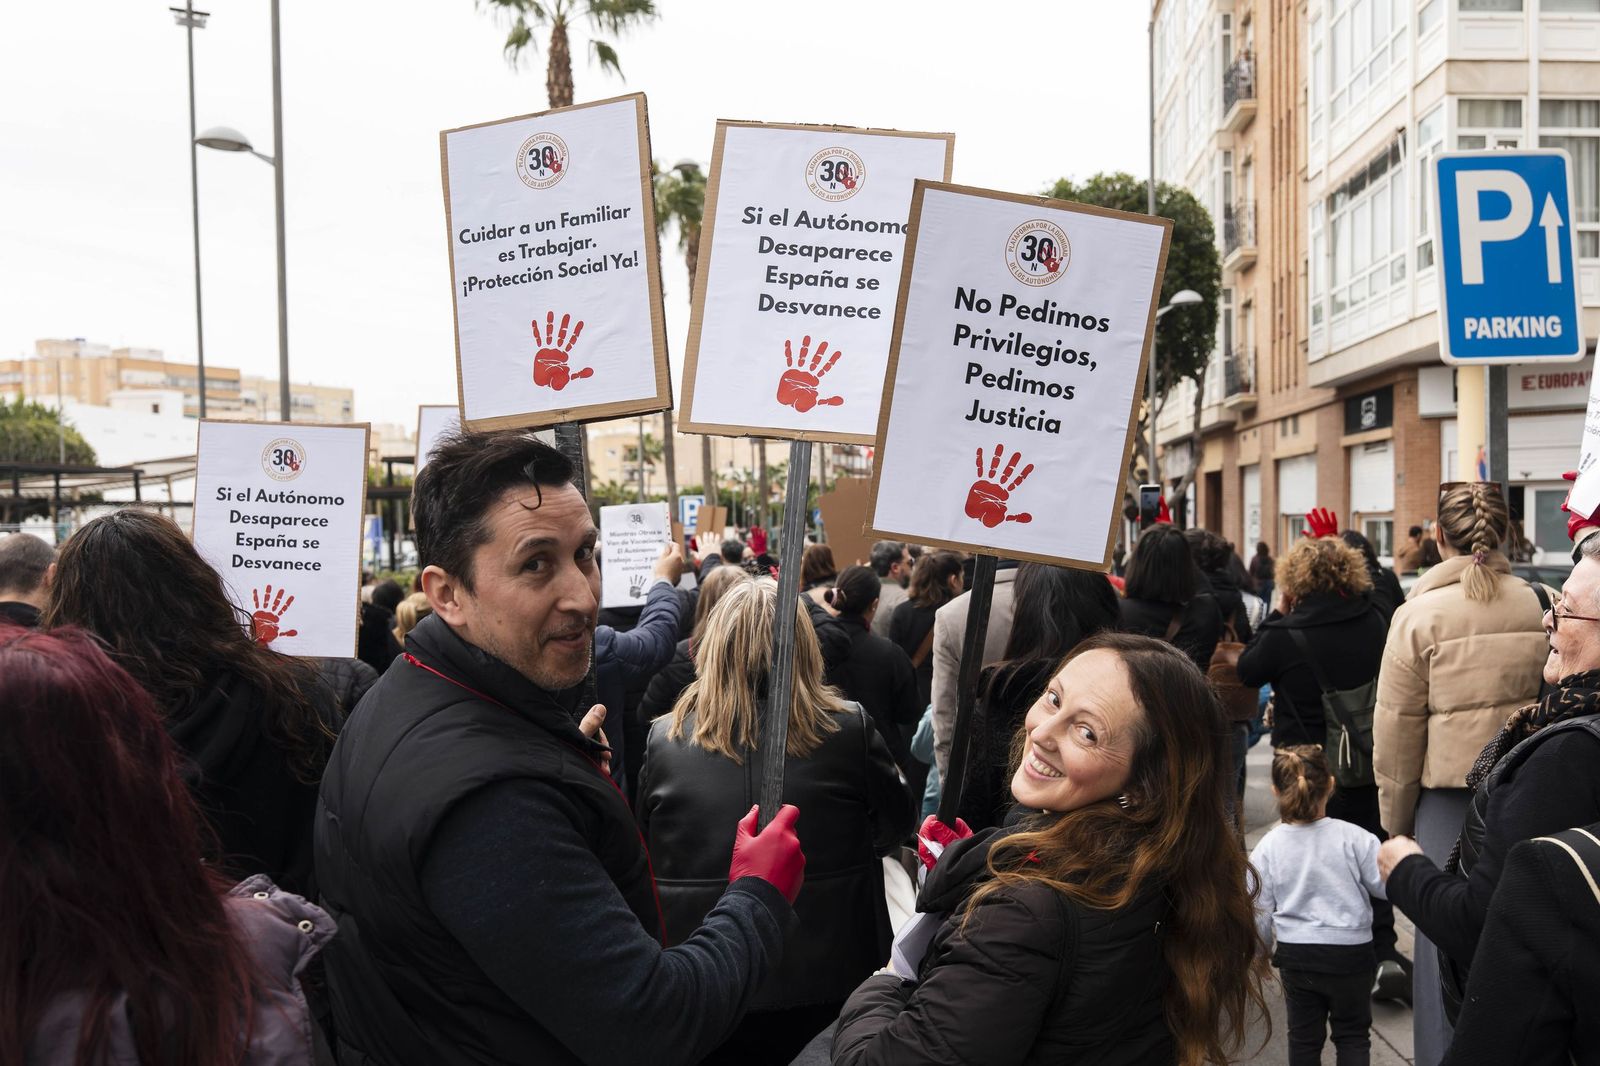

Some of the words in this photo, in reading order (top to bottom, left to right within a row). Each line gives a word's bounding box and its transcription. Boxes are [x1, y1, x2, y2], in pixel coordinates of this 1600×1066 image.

[529, 146, 554, 170] 30
[820, 160, 849, 182] 30
[460, 224, 515, 244] Cuidar
[520, 224, 530, 234] a
[535, 220, 556, 232] un
[561, 206, 631, 228] Familiar
[742, 207, 763, 224] Si
[769, 208, 788, 226] el
[1455, 170, 1534, 285] P
[499, 251, 515, 262] es
[519, 236, 596, 256] Trabajar.
[759, 236, 892, 262] Desaparece
[1008, 223, 1035, 252] PLATAFORMA
[1048, 225, 1056, 233] LA
[1021, 235, 1053, 263] 30
[463, 266, 553, 297] ¡Protección
[558, 255, 607, 278] Social
[610, 251, 638, 269] Ya!
[766, 265, 848, 290] España
[856, 278, 879, 290] se
[1015, 270, 1026, 281] LOS
[759, 294, 881, 319] Desvanece
[954, 287, 991, 313] No
[999, 294, 1109, 332] Pedimos
[1464, 316, 1562, 339] PARKING
[953, 324, 1097, 371] Privilegios,
[965, 362, 1075, 400] Pedimos
[965, 399, 1061, 434] Justicia
[216, 487, 231, 501] Si
[237, 488, 250, 501] el
[255, 489, 344, 505] Autónomo
[230, 510, 328, 529] Desaparece
[236, 532, 297, 550] España
[303, 540, 319, 548] se
[232, 554, 321, 571] Desvanece
